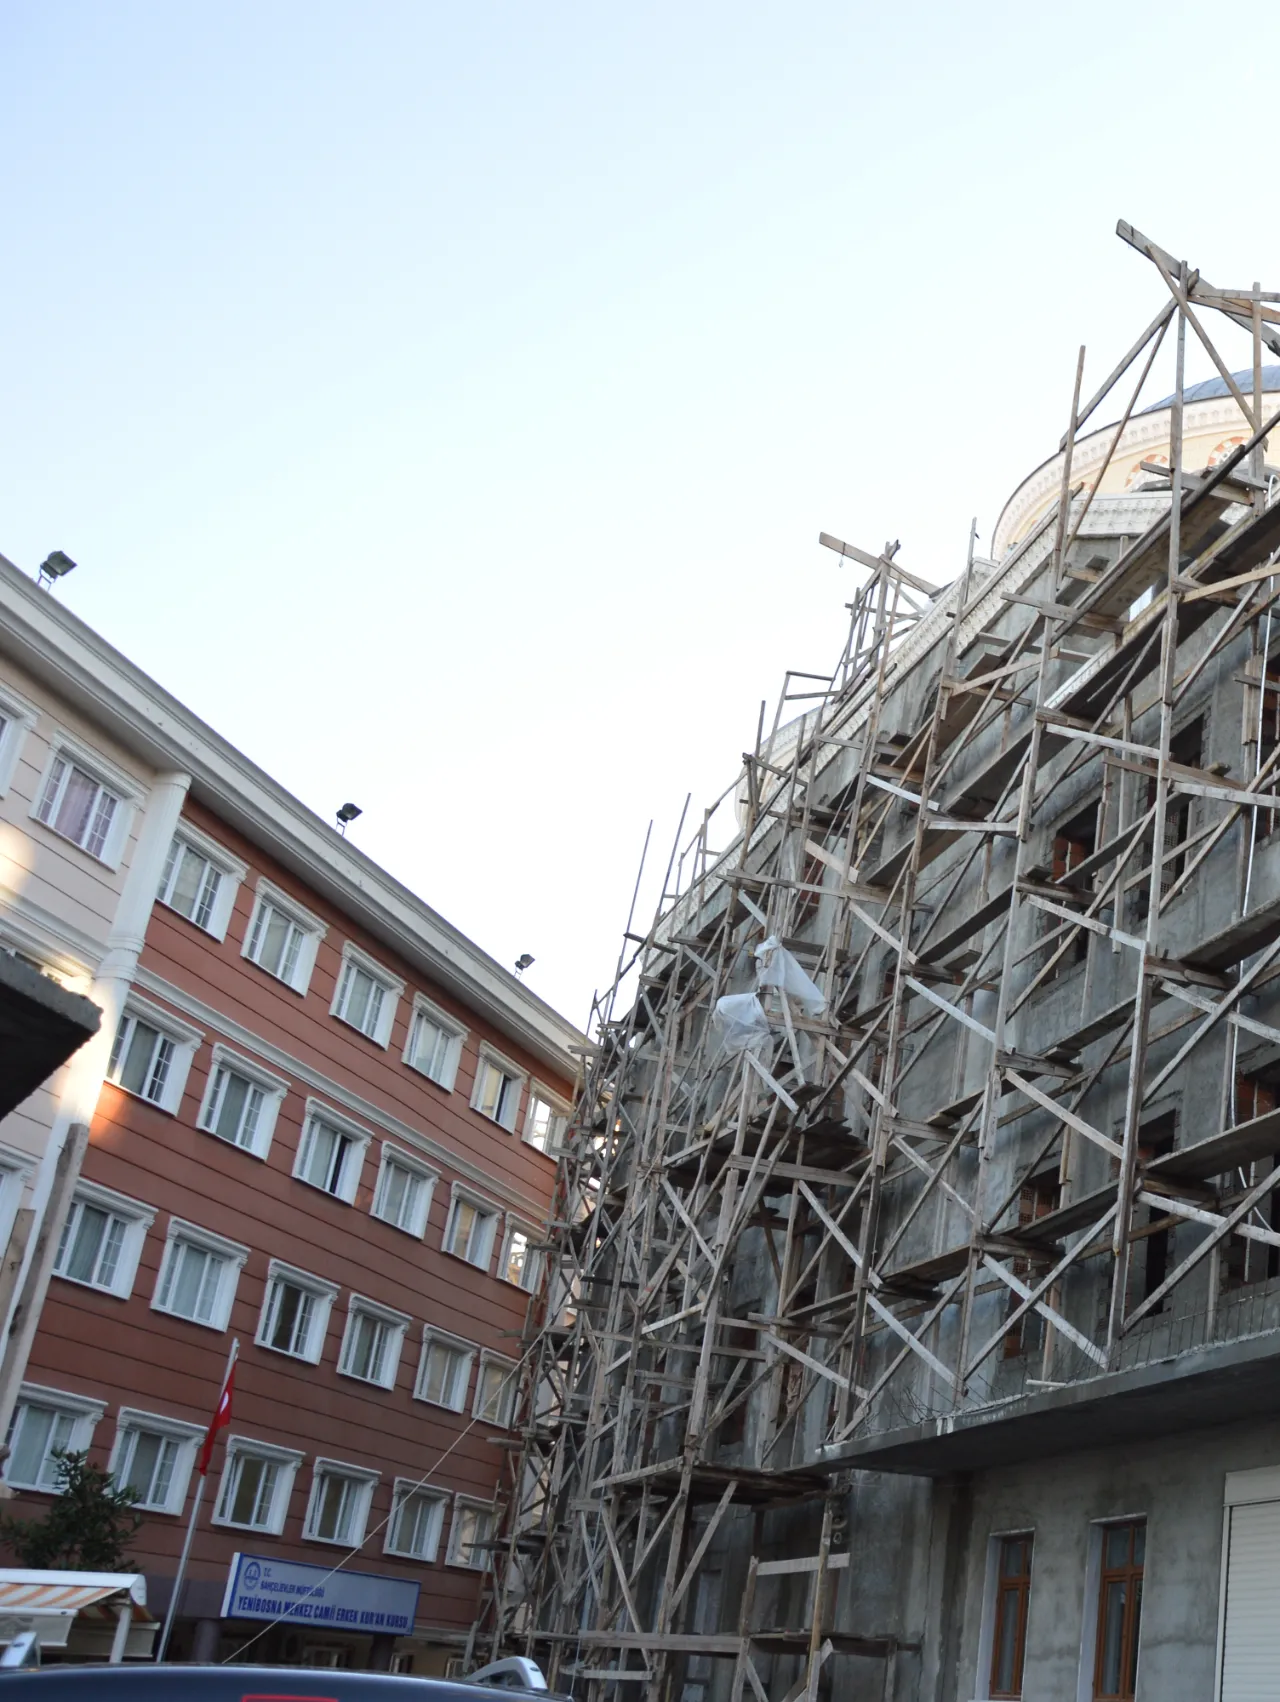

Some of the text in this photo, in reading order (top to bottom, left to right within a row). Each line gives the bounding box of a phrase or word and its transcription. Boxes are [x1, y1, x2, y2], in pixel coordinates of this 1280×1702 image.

[238, 1594, 282, 1614] YENİBOSNA
[283, 1600, 313, 1618] MERKEZ
[336, 1608, 359, 1623] ERKEK
[359, 1611, 385, 1625] KUR'AN
[386, 1614, 409, 1629] KURSU
